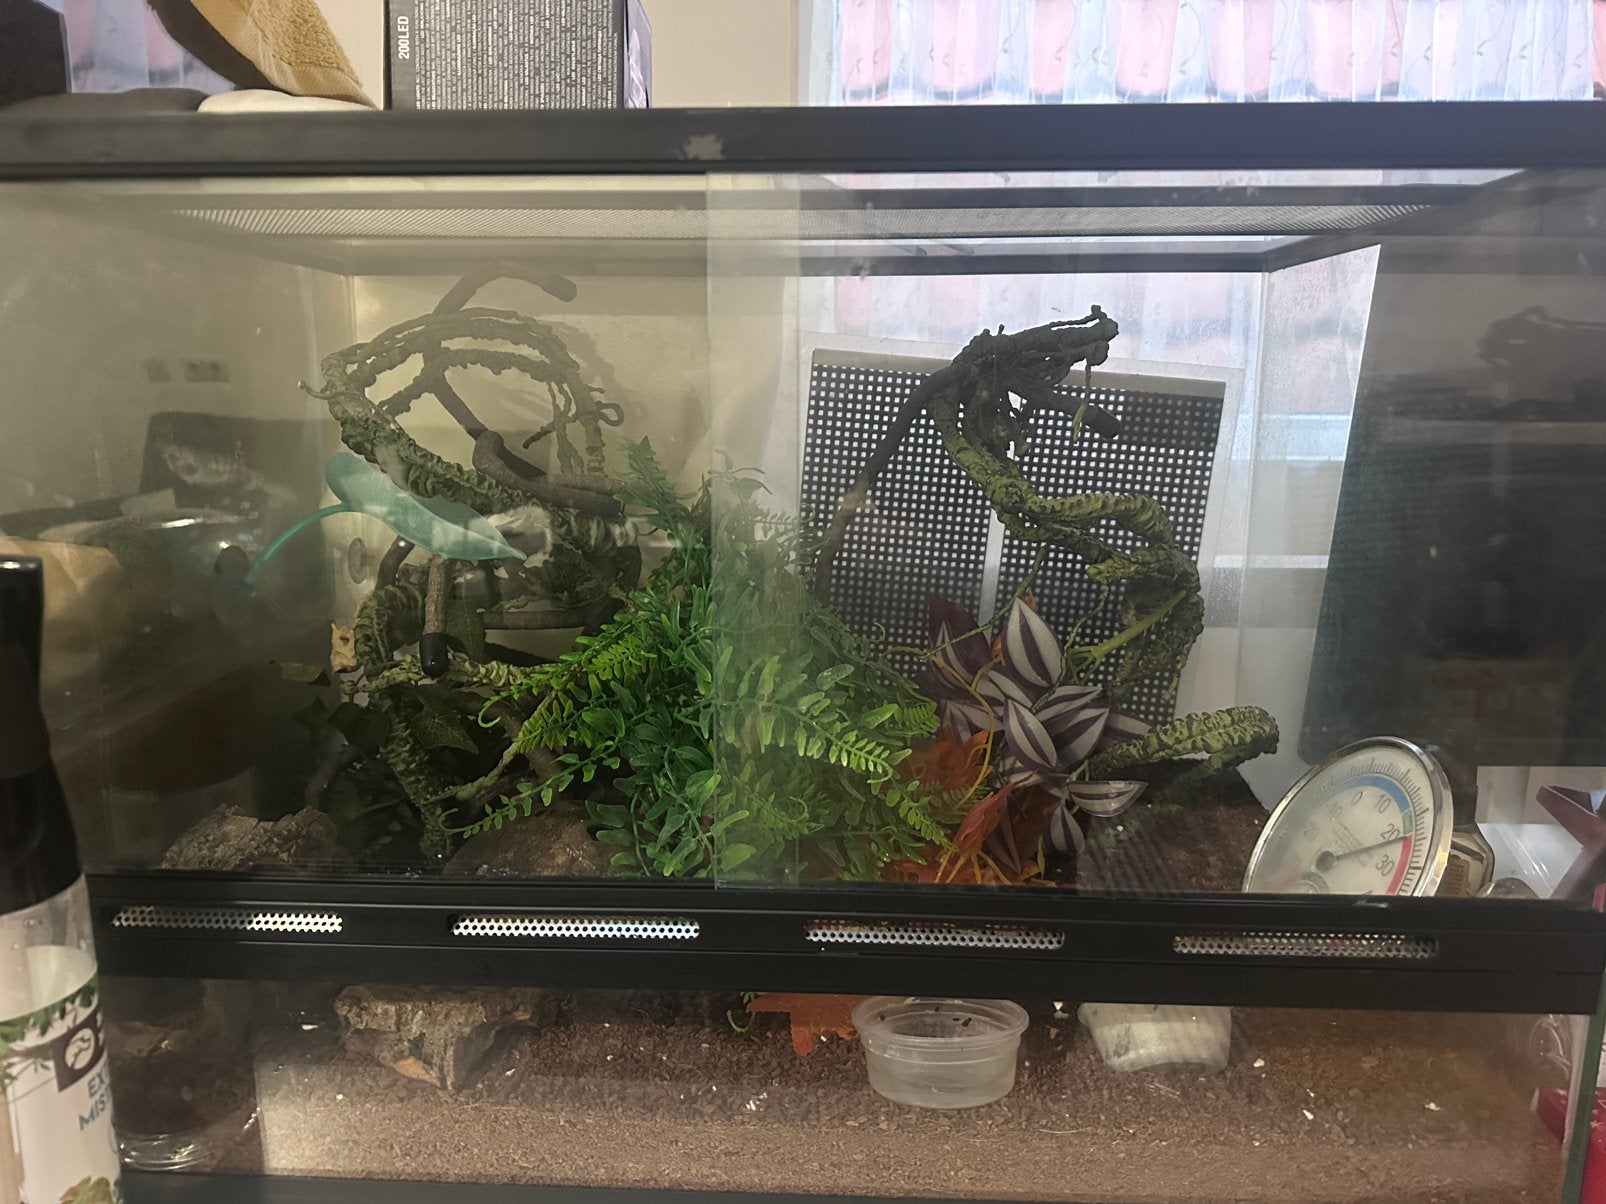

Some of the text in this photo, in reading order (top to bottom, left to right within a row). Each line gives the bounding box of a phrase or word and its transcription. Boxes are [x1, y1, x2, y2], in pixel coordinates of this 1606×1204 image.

[397, 15, 410, 60] 200LED
[1350, 790, 1363, 806] 0
[1373, 793, 1392, 814] 10
[1380, 822, 1401, 842] 20
[1375, 853, 1395, 878] 30
